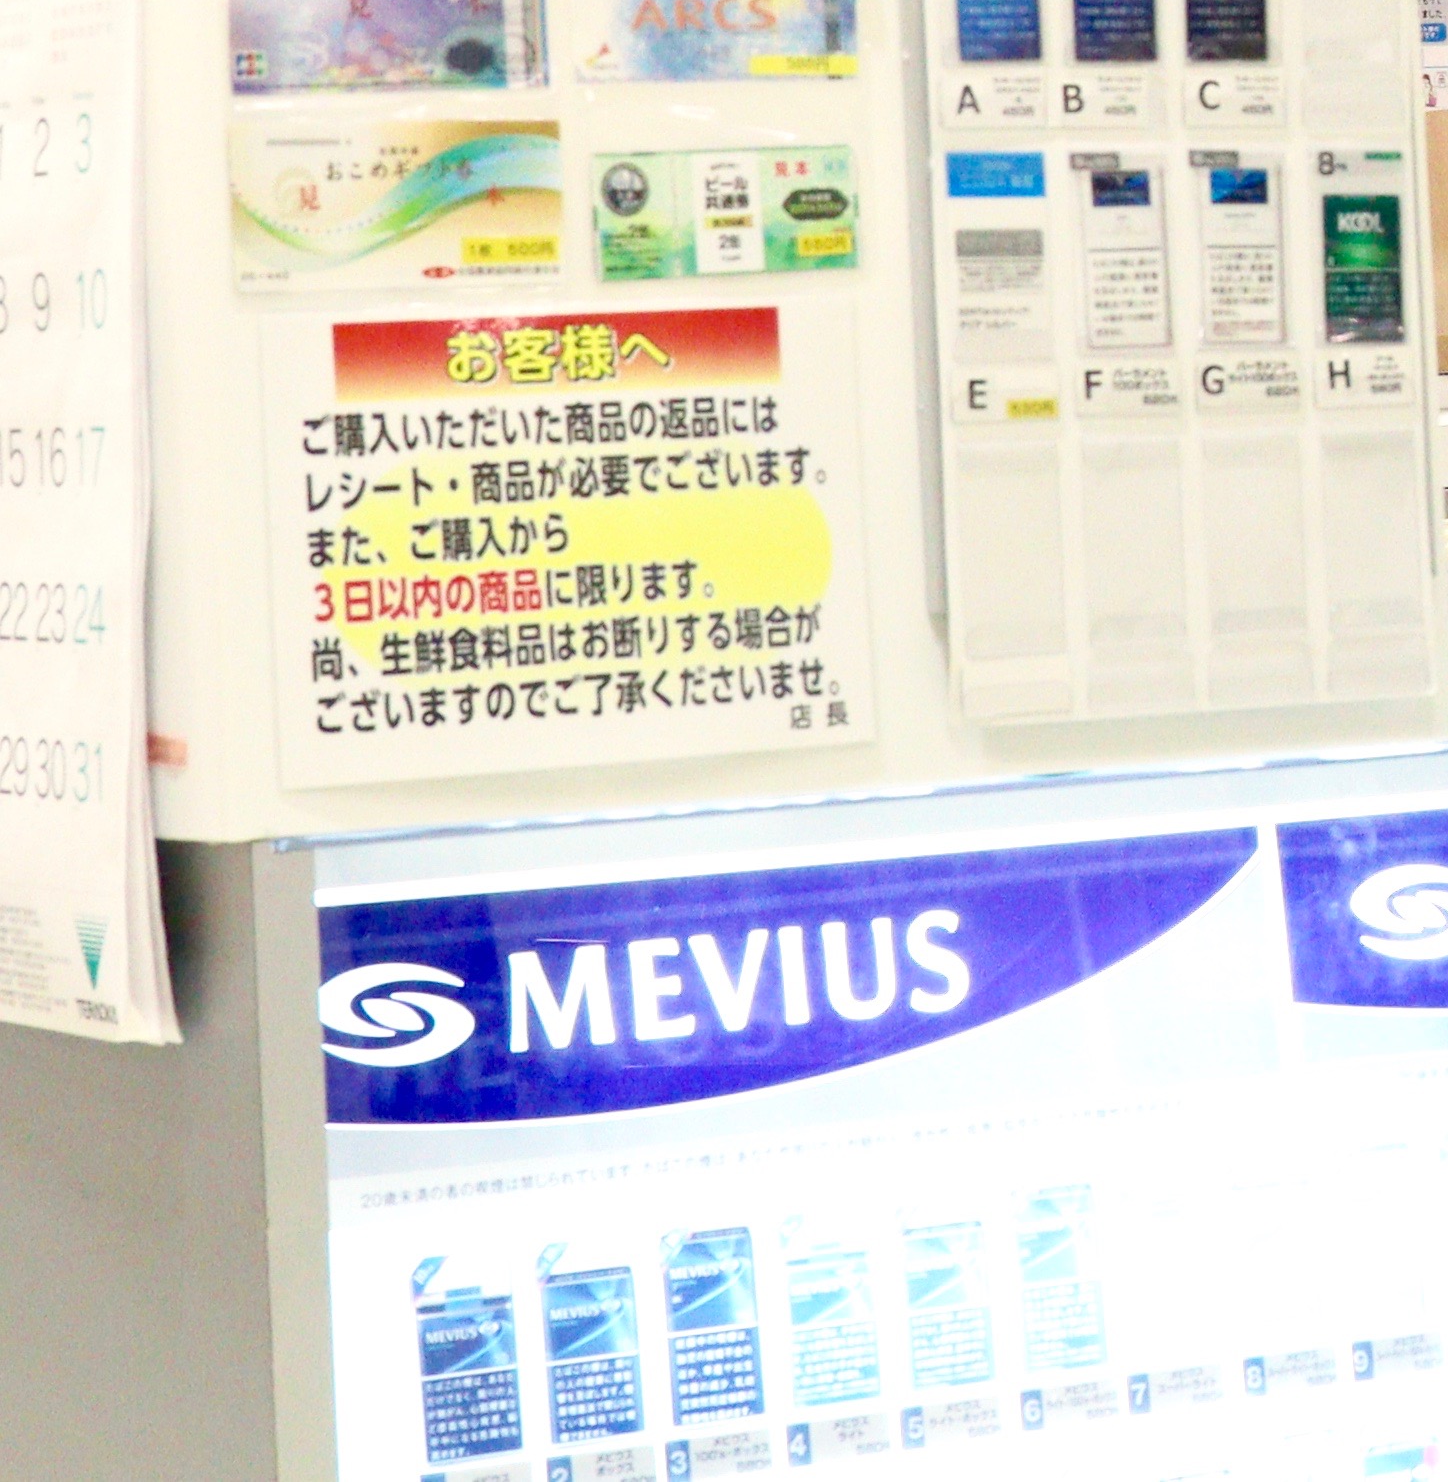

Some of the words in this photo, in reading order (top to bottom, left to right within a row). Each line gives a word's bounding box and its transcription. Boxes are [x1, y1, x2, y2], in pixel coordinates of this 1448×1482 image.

[957, 84, 981, 115] A
[1062, 84, 1085, 114] B
[1199, 80, 1220, 110] C
[1336, 211, 1385, 234] KOOL
[446, 324, 671, 385] お客様へ
[1201, 364, 1225, 395] G
[1328, 359, 1352, 390] H
[967, 379, 988, 410] E
[1085, 370, 1103, 400] F
[302, 395, 779, 456] ご購入いただいた商品の返品には
[33, 427, 67, 488] 16
[74, 427, 106, 487] 17
[305, 448, 830, 513] レシート・商品が必要でございます。
[306, 512, 571, 569] また、ご購入から
[34, 582, 68, 644] 23
[313, 558, 716, 624] 3日以内の商品に限ります。
[311, 602, 822, 683] 尚、生鮮食料品はお断りする場合が
[313, 659, 842, 735] ございますのでご了承くださいませ。
[505, 908, 972, 1057] MEVIUS
